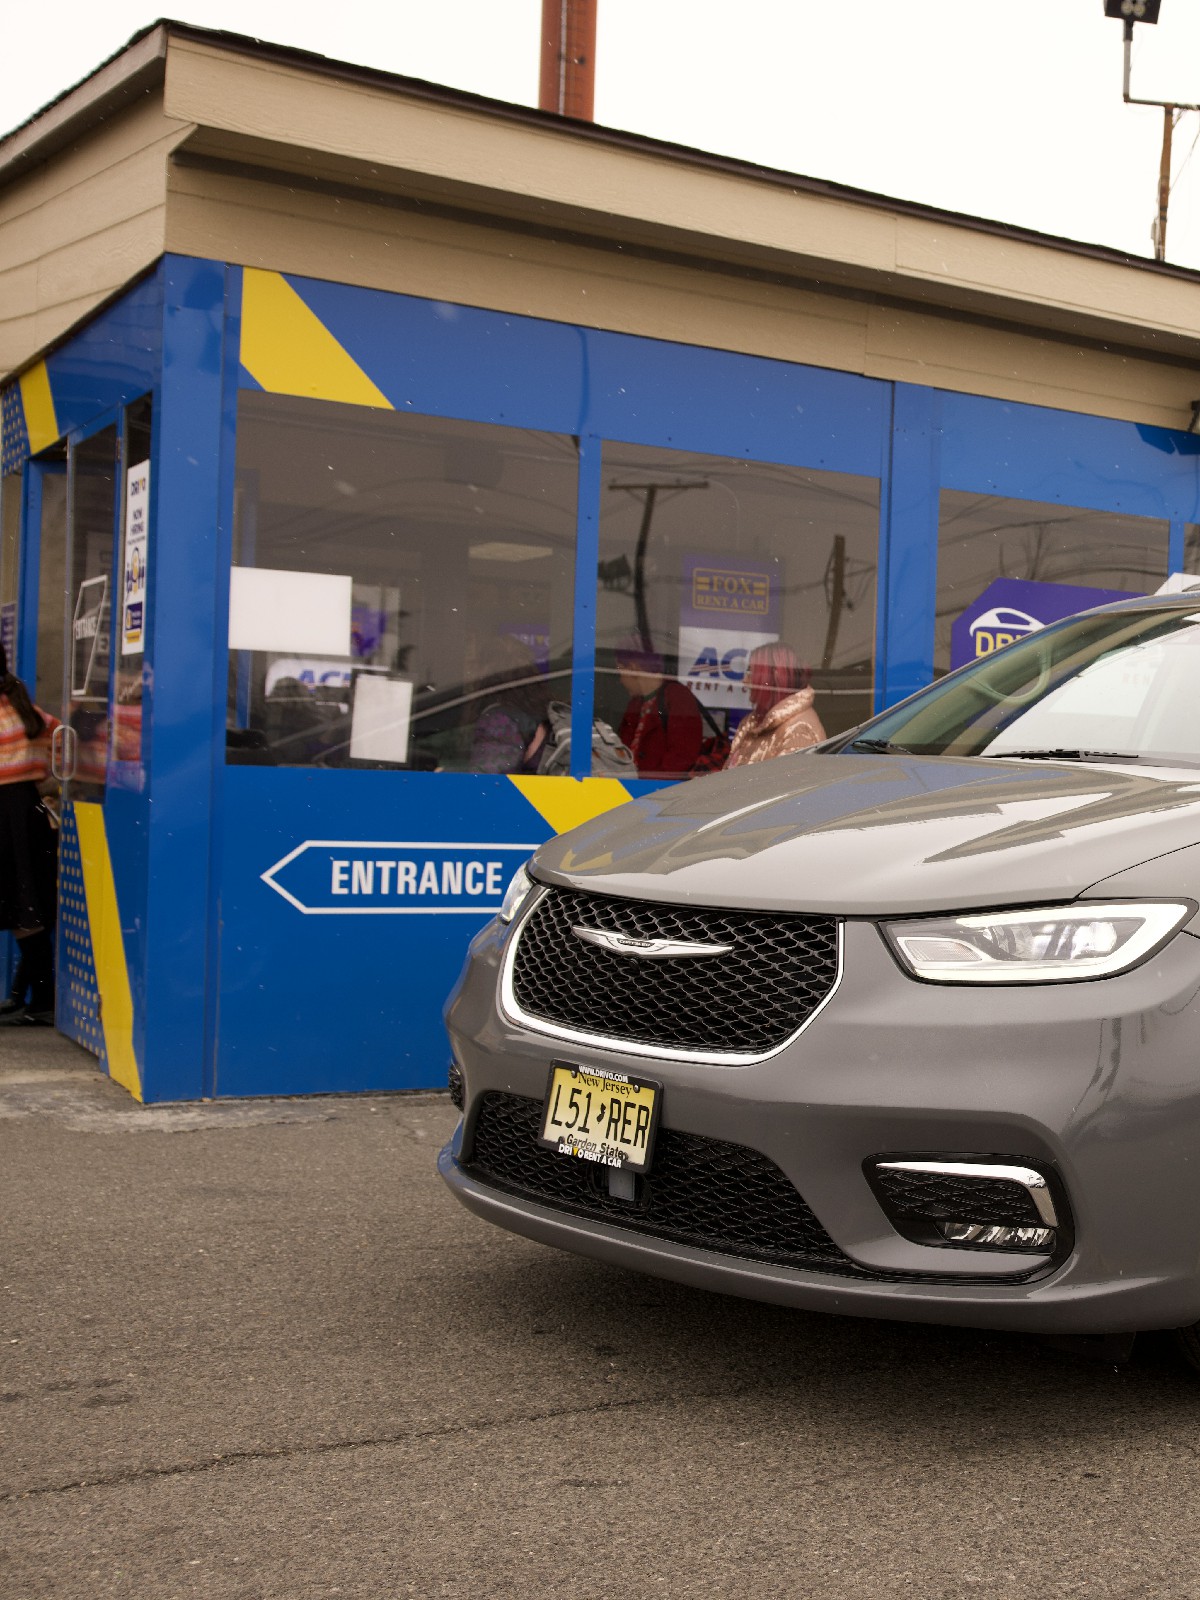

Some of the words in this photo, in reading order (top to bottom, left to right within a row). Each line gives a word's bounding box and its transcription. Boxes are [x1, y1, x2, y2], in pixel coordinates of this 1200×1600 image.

[712, 575, 753, 595] FOX
[697, 595, 727, 607] RENT
[730, 598, 739, 608] A
[741, 598, 765, 610] CAR
[331, 860, 503, 895] ENTRANCE
[578, 1073, 600, 1087] New
[601, 1078, 632, 1098] Jersey
[551, 1084, 592, 1134] L51
[605, 1098, 650, 1148] RER
[558, 1144, 584, 1158] DRIVO
[584, 1151, 601, 1163] RENT
[601, 1156, 607, 1164] A
[608, 1158, 622, 1168] CAR
[566, 1134, 597, 1151] Garden
[599, 1142, 625, 1158] State
